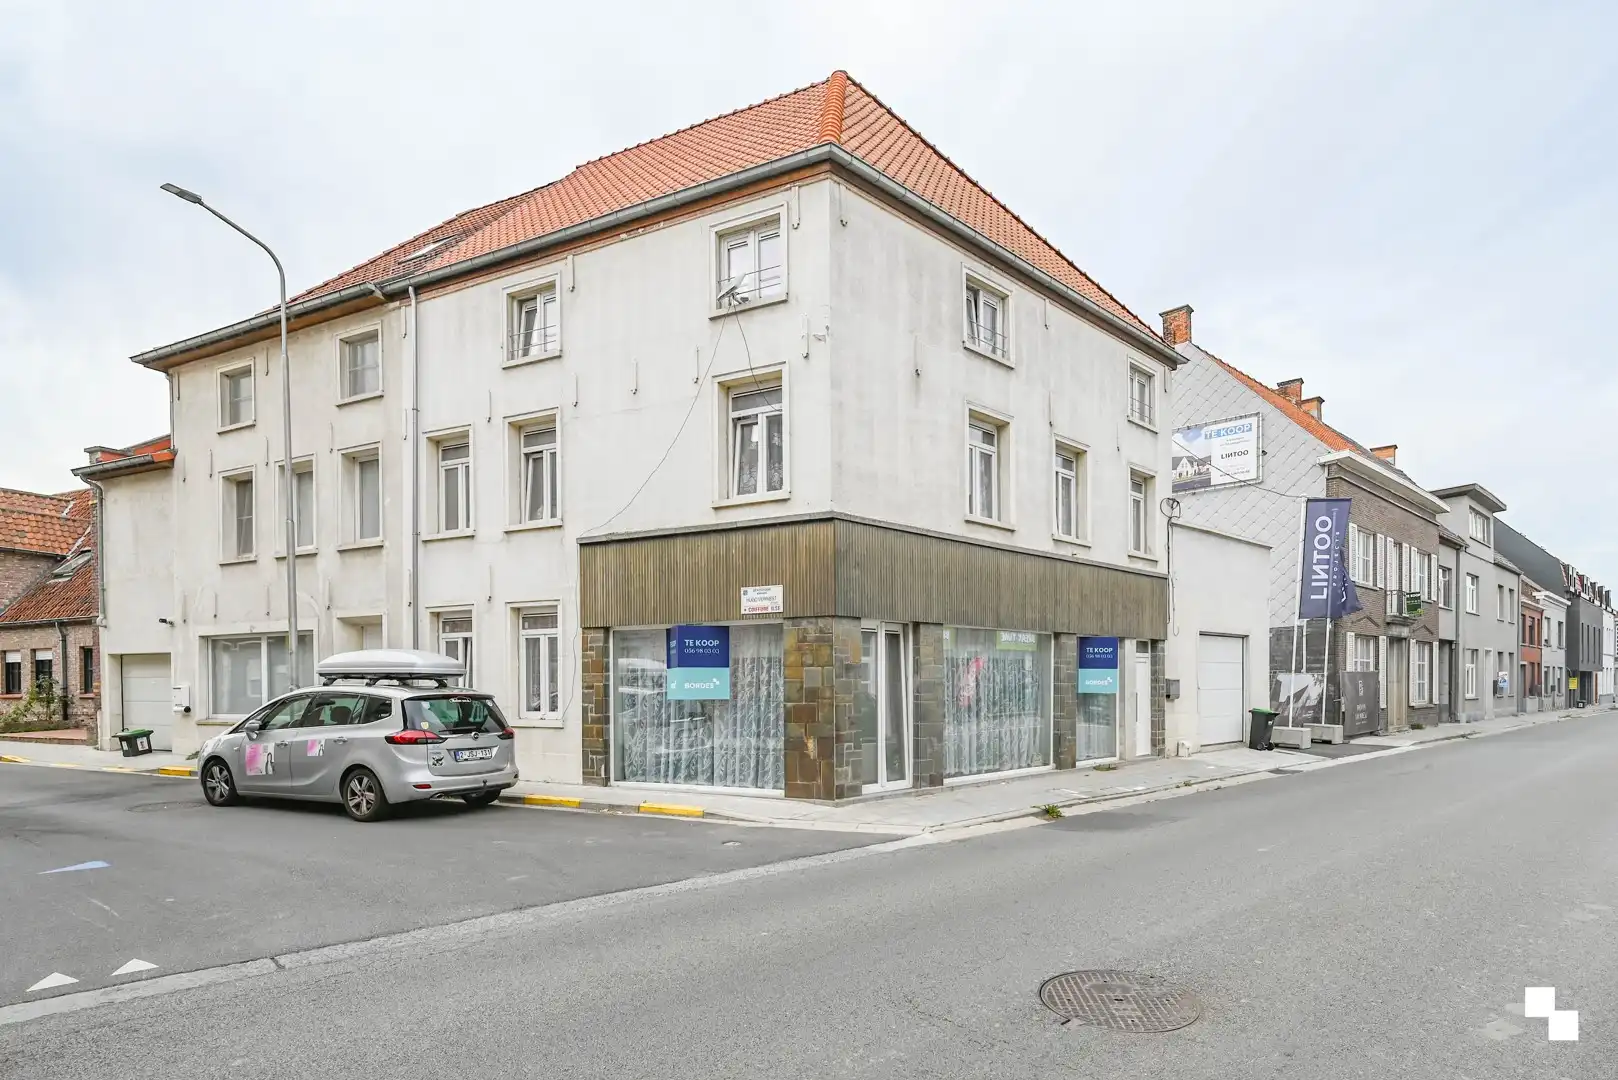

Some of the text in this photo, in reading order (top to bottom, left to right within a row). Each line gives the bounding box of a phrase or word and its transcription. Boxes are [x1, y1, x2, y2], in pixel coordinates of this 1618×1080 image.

[1204, 422, 1251, 439] TE KOOP
[1310, 515, 1333, 600] LINTOO
[684, 639, 695, 647] TE
[695, 639, 720, 647] KOOP
